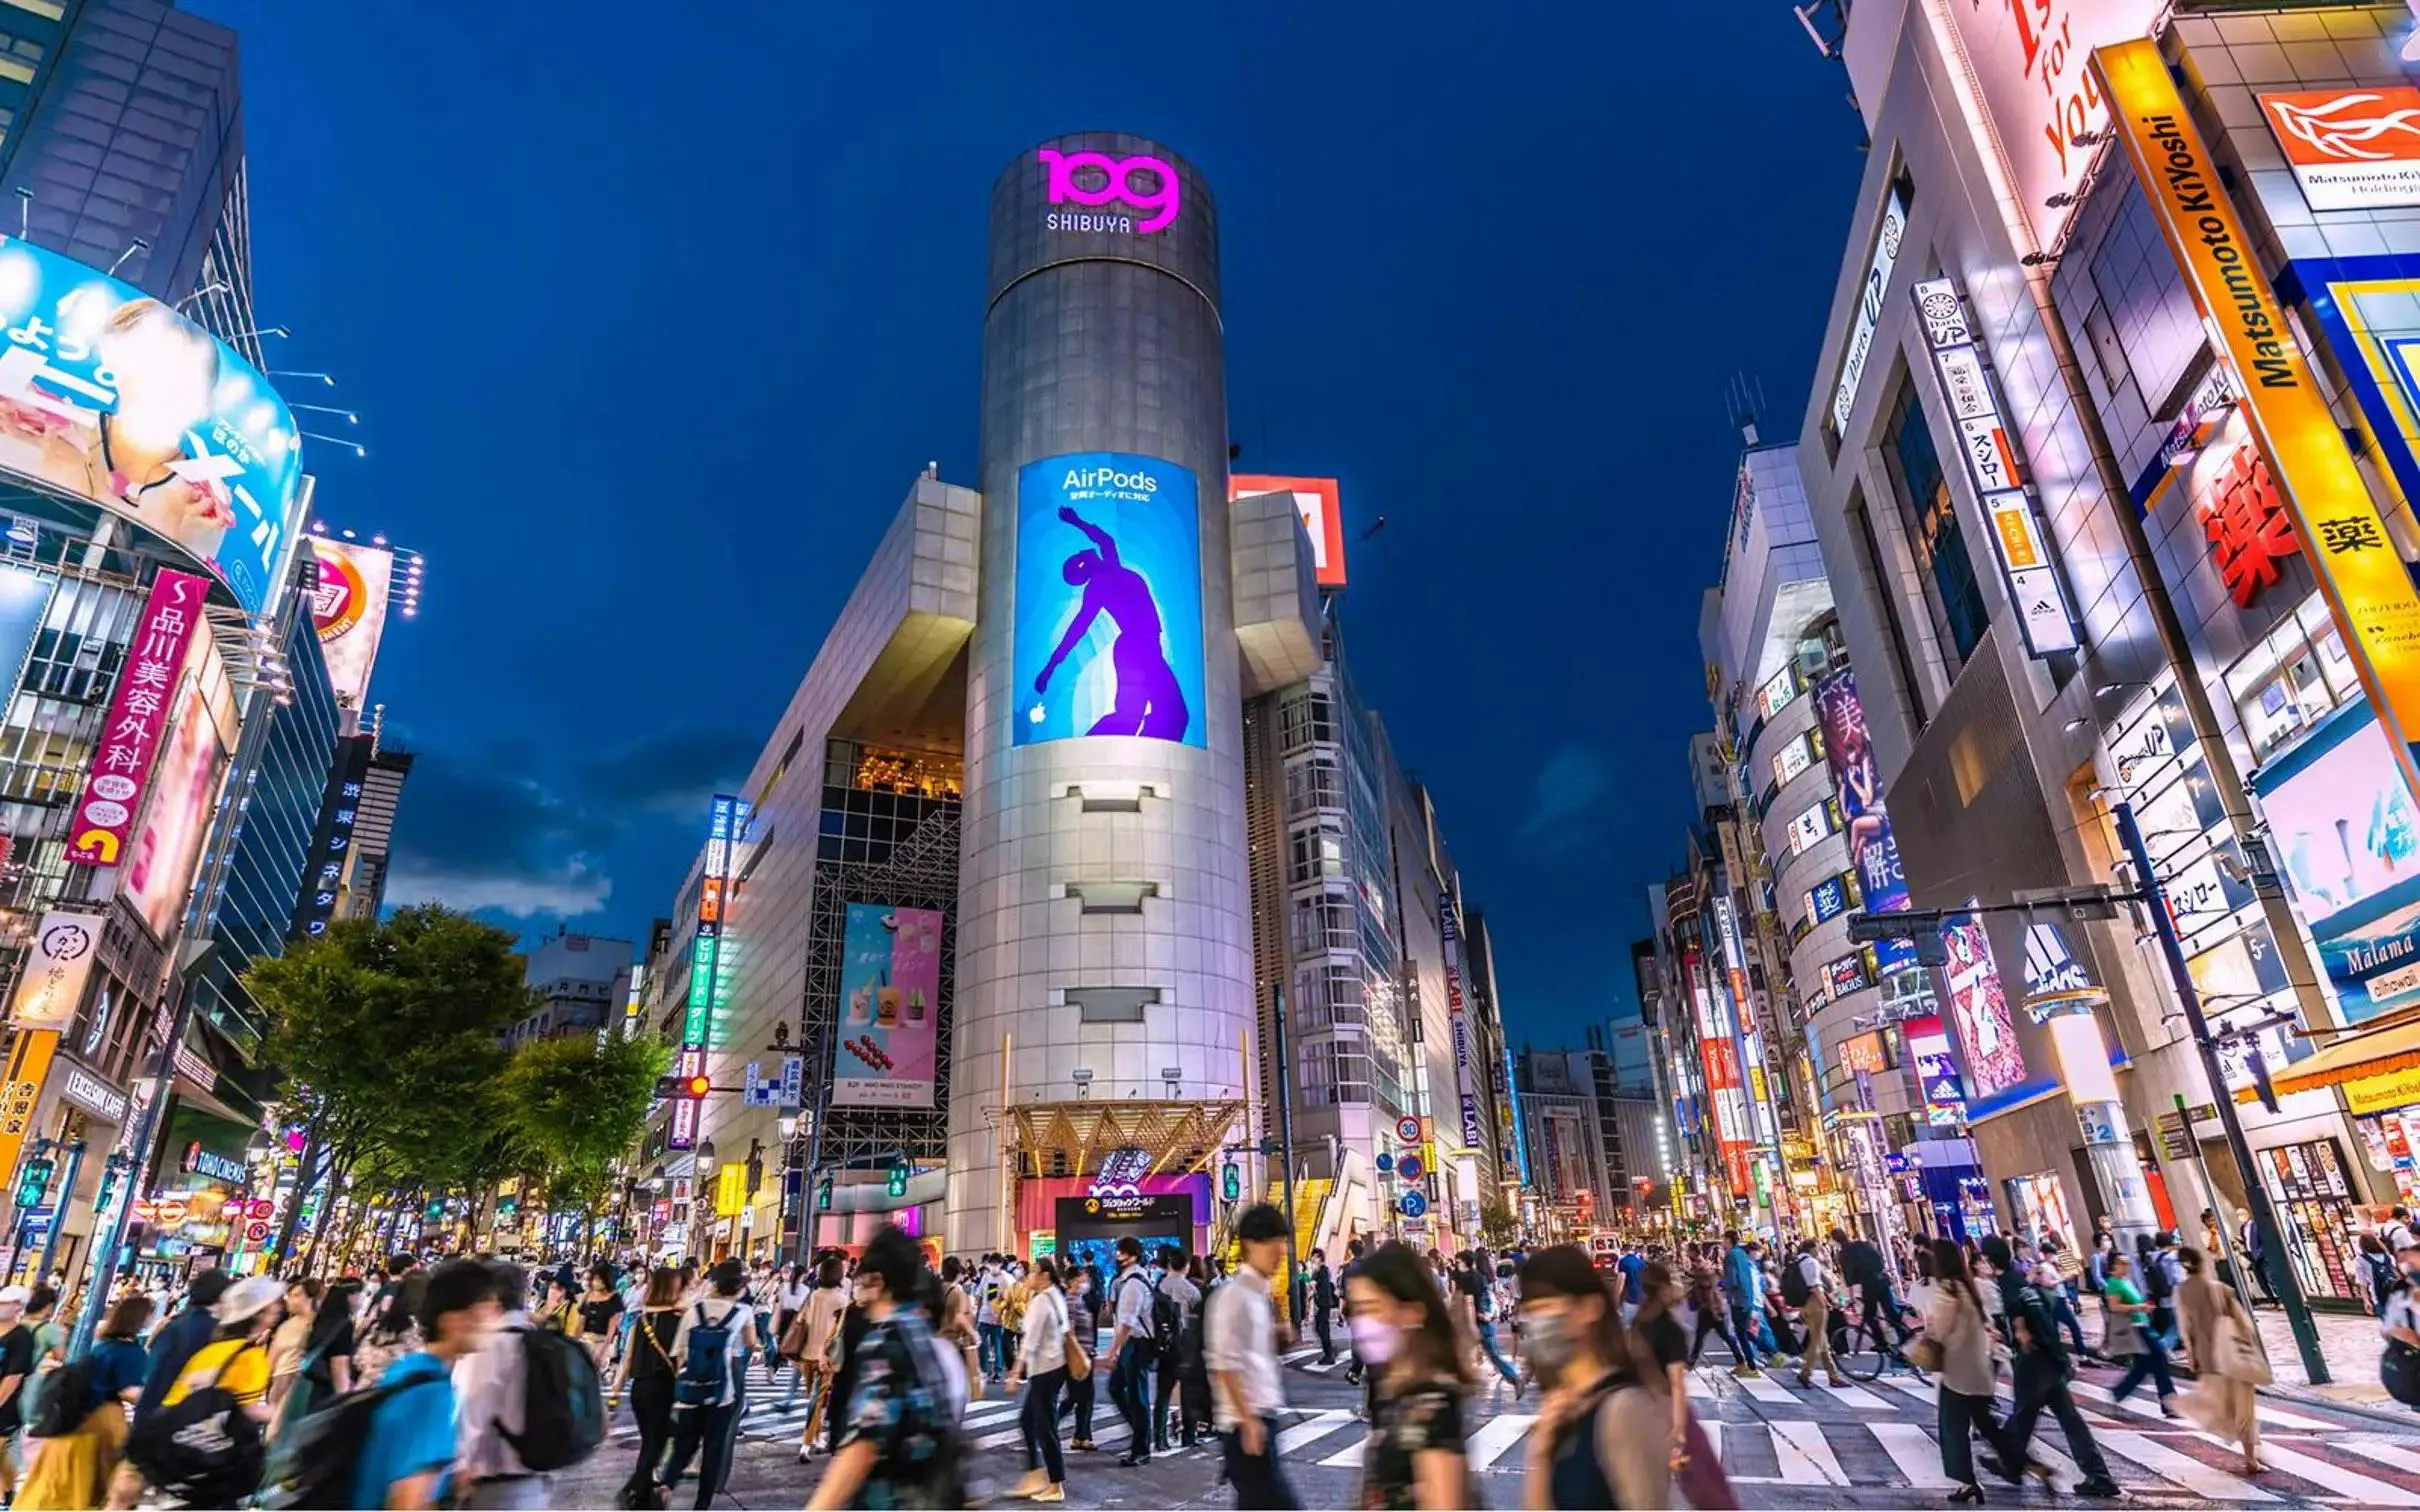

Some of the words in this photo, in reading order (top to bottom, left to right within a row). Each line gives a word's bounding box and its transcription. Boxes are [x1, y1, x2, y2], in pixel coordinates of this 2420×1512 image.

[2042, 12, 2071, 97] for
[1039, 149, 1180, 233] 109
[1047, 213, 1131, 234] SHIBUYA
[2199, 213, 2298, 388] Matsumoto
[1849, 327, 1869, 382] Darts
[1865, 267, 1883, 327] UP
[1929, 316, 1962, 330] Darts
[1932, 326, 1966, 346] UP
[1062, 467, 1158, 493] AirPods
[1973, 434, 1998, 488] スシロー
[1991, 499, 2000, 508] 5
[2318, 516, 2383, 554] 薬
[104, 606, 186, 774] 品川美容外科
[1834, 694, 1864, 744] 美
[2173, 882, 2218, 913] スシロー
[2345, 934, 2415, 976] Malama
[1454, 1021, 1468, 1068] SHIBUYA
[1402, 1122, 1417, 1136] 30
[1464, 1108, 1477, 1148] LABI
